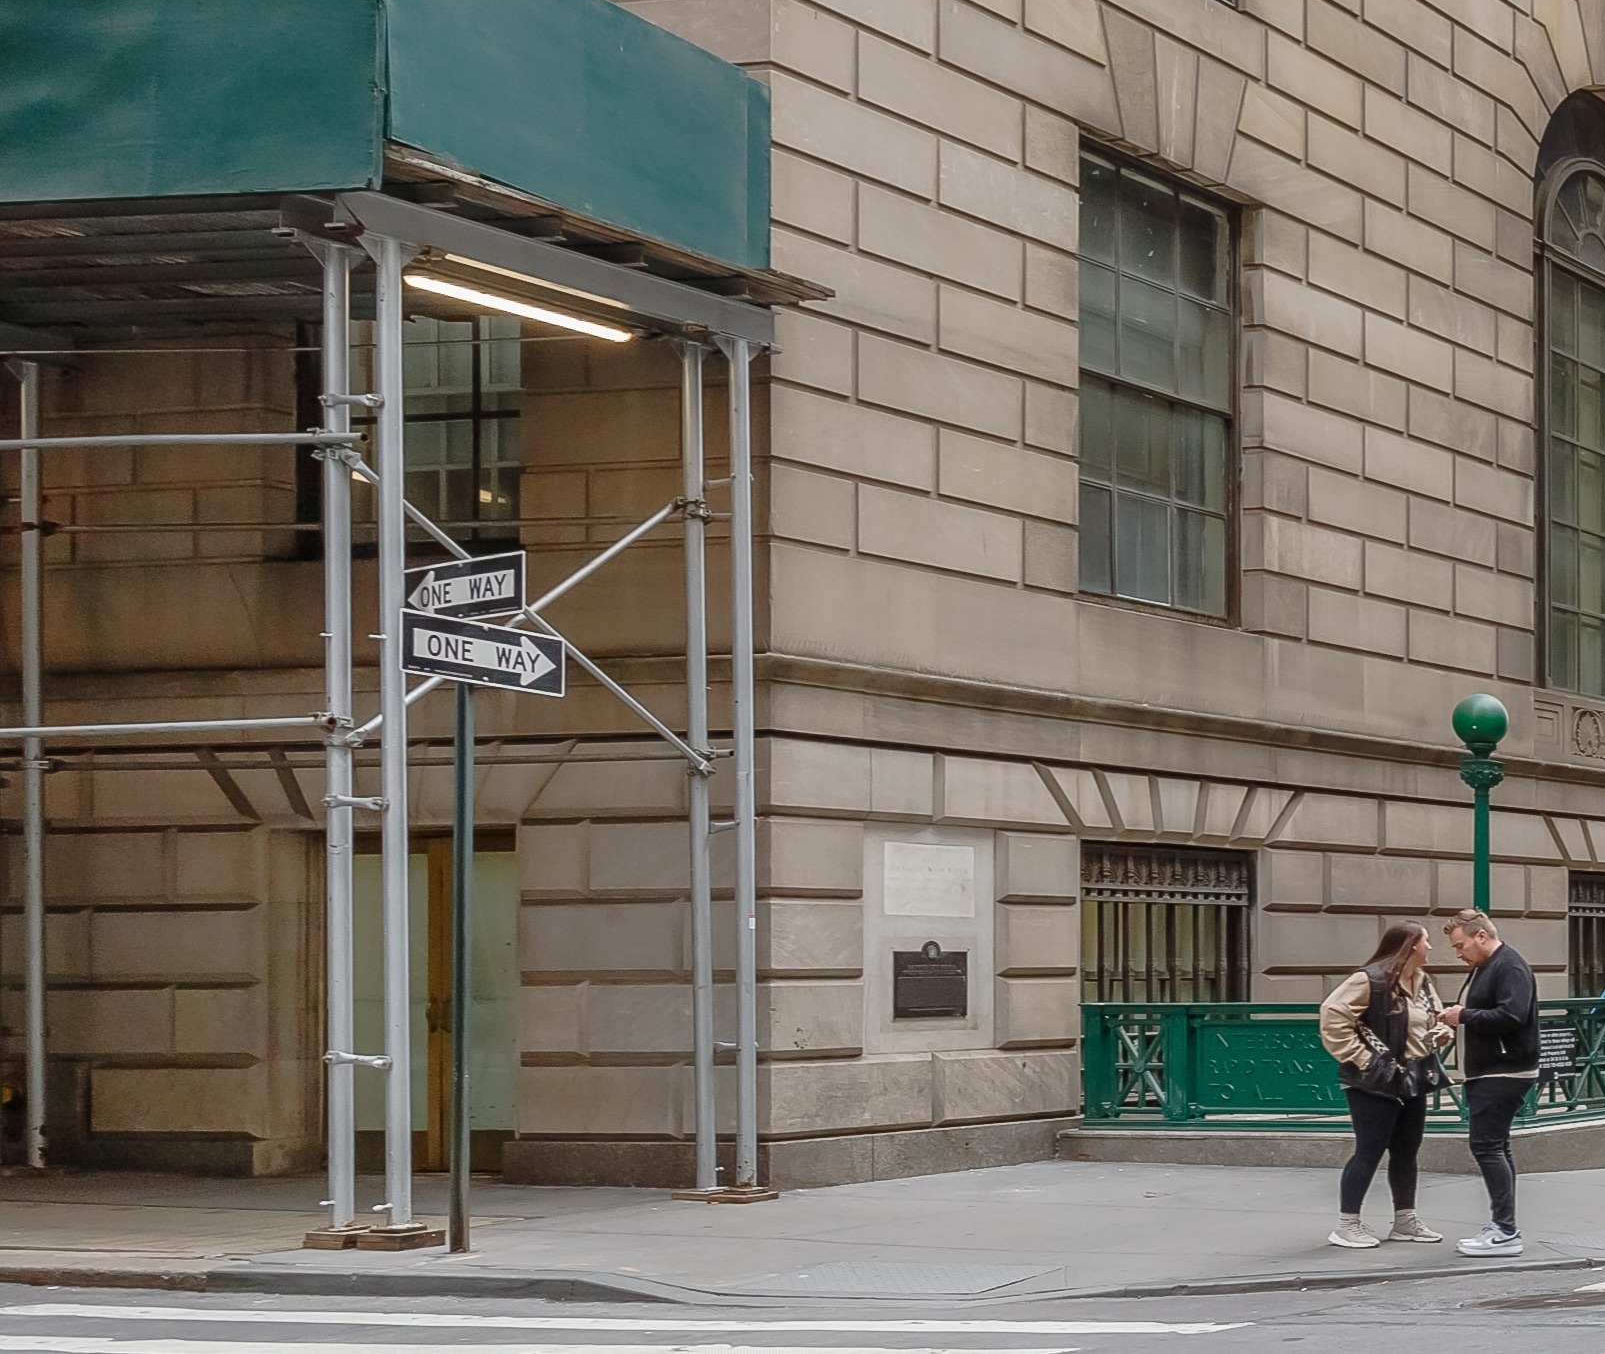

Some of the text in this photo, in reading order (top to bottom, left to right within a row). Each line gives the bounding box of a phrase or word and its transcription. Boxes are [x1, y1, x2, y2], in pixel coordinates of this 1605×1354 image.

[420, 573, 508, 607] ONE WAY
[427, 634, 541, 673] ONE WAY
